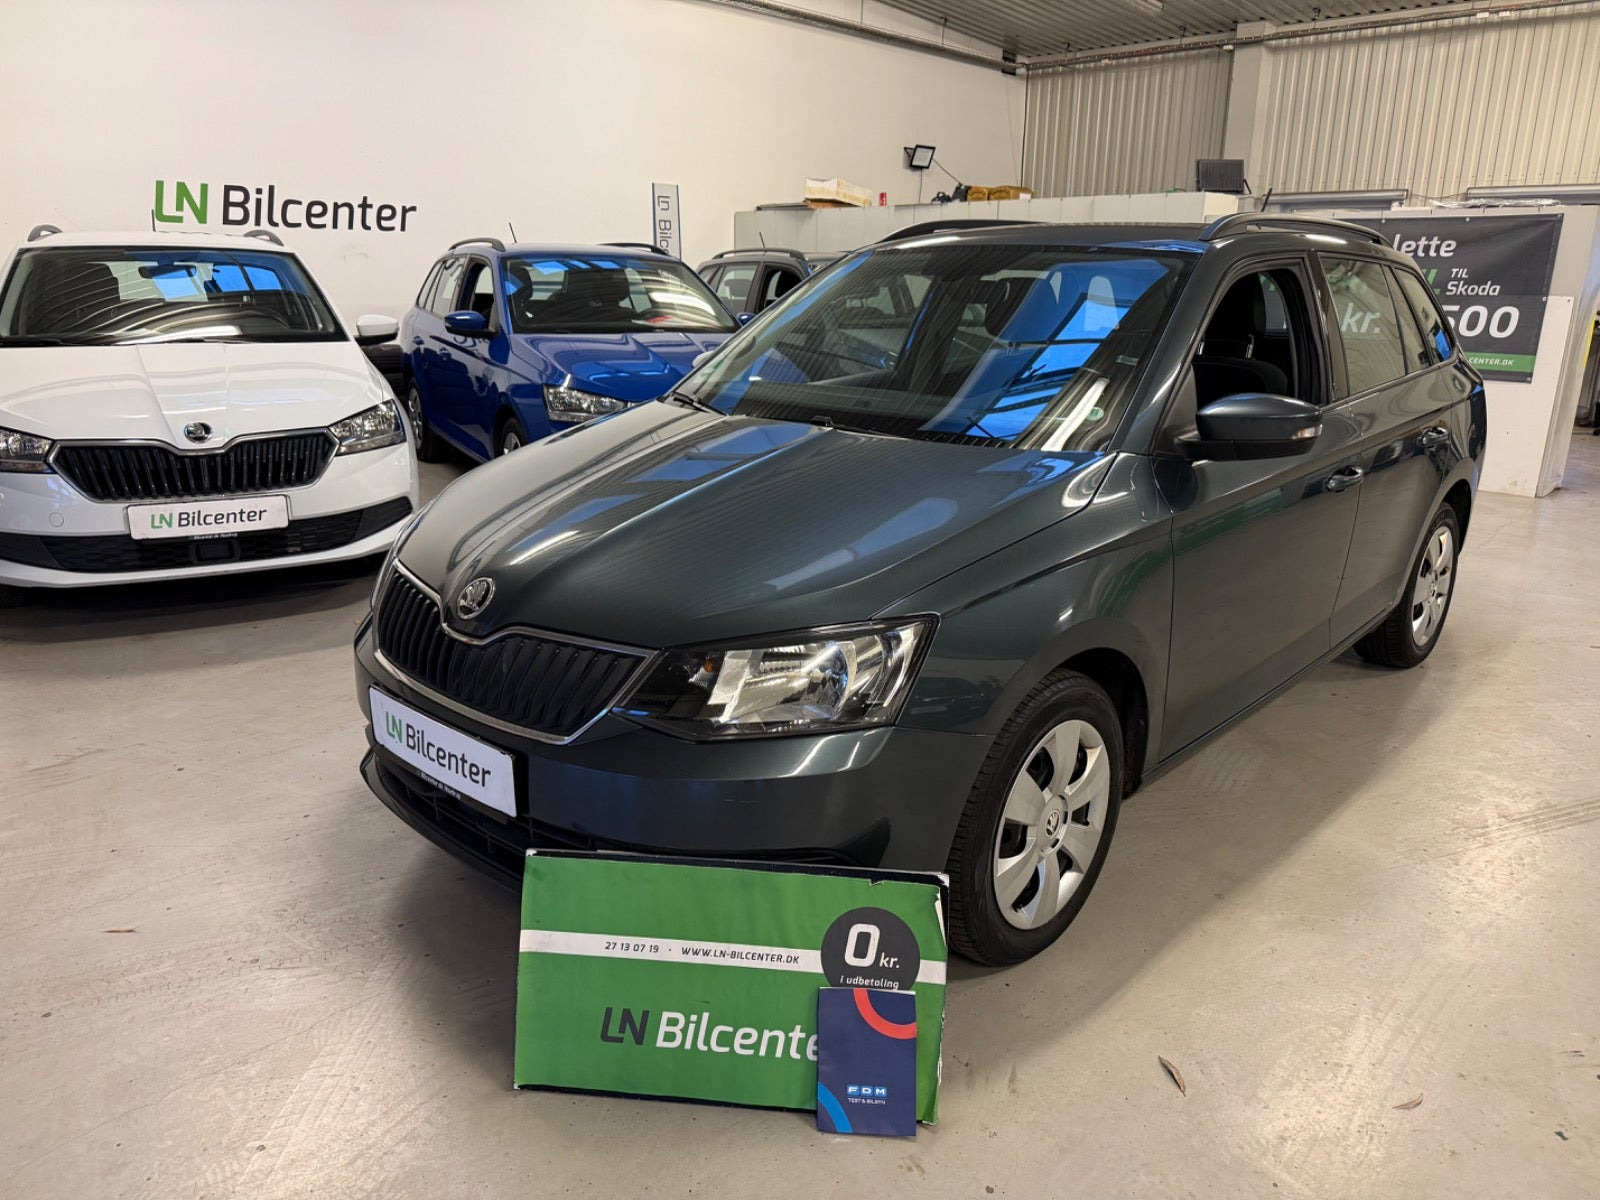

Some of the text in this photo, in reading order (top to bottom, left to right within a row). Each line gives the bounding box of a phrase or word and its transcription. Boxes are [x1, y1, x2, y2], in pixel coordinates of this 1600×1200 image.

[154, 180, 417, 232] LN Bilcenter
[1451, 268, 1469, 278] TIL
[1446, 280, 1501, 296] Skoda
[1341, 303, 1381, 334] kr.
[150, 507, 267, 529] LN Bilcenter
[386, 711, 403, 744] LN
[405, 723, 491, 788] Bilcenter
[604, 941, 800, 965] 27 13 07 19 WWW.LN-BILCENTER.DK
[844, 923, 900, 969] 0 kr.
[839, 975, 900, 991] i udbetaling
[600, 1007, 651, 1047] LN
[847, 1085, 886, 1096] FDM
